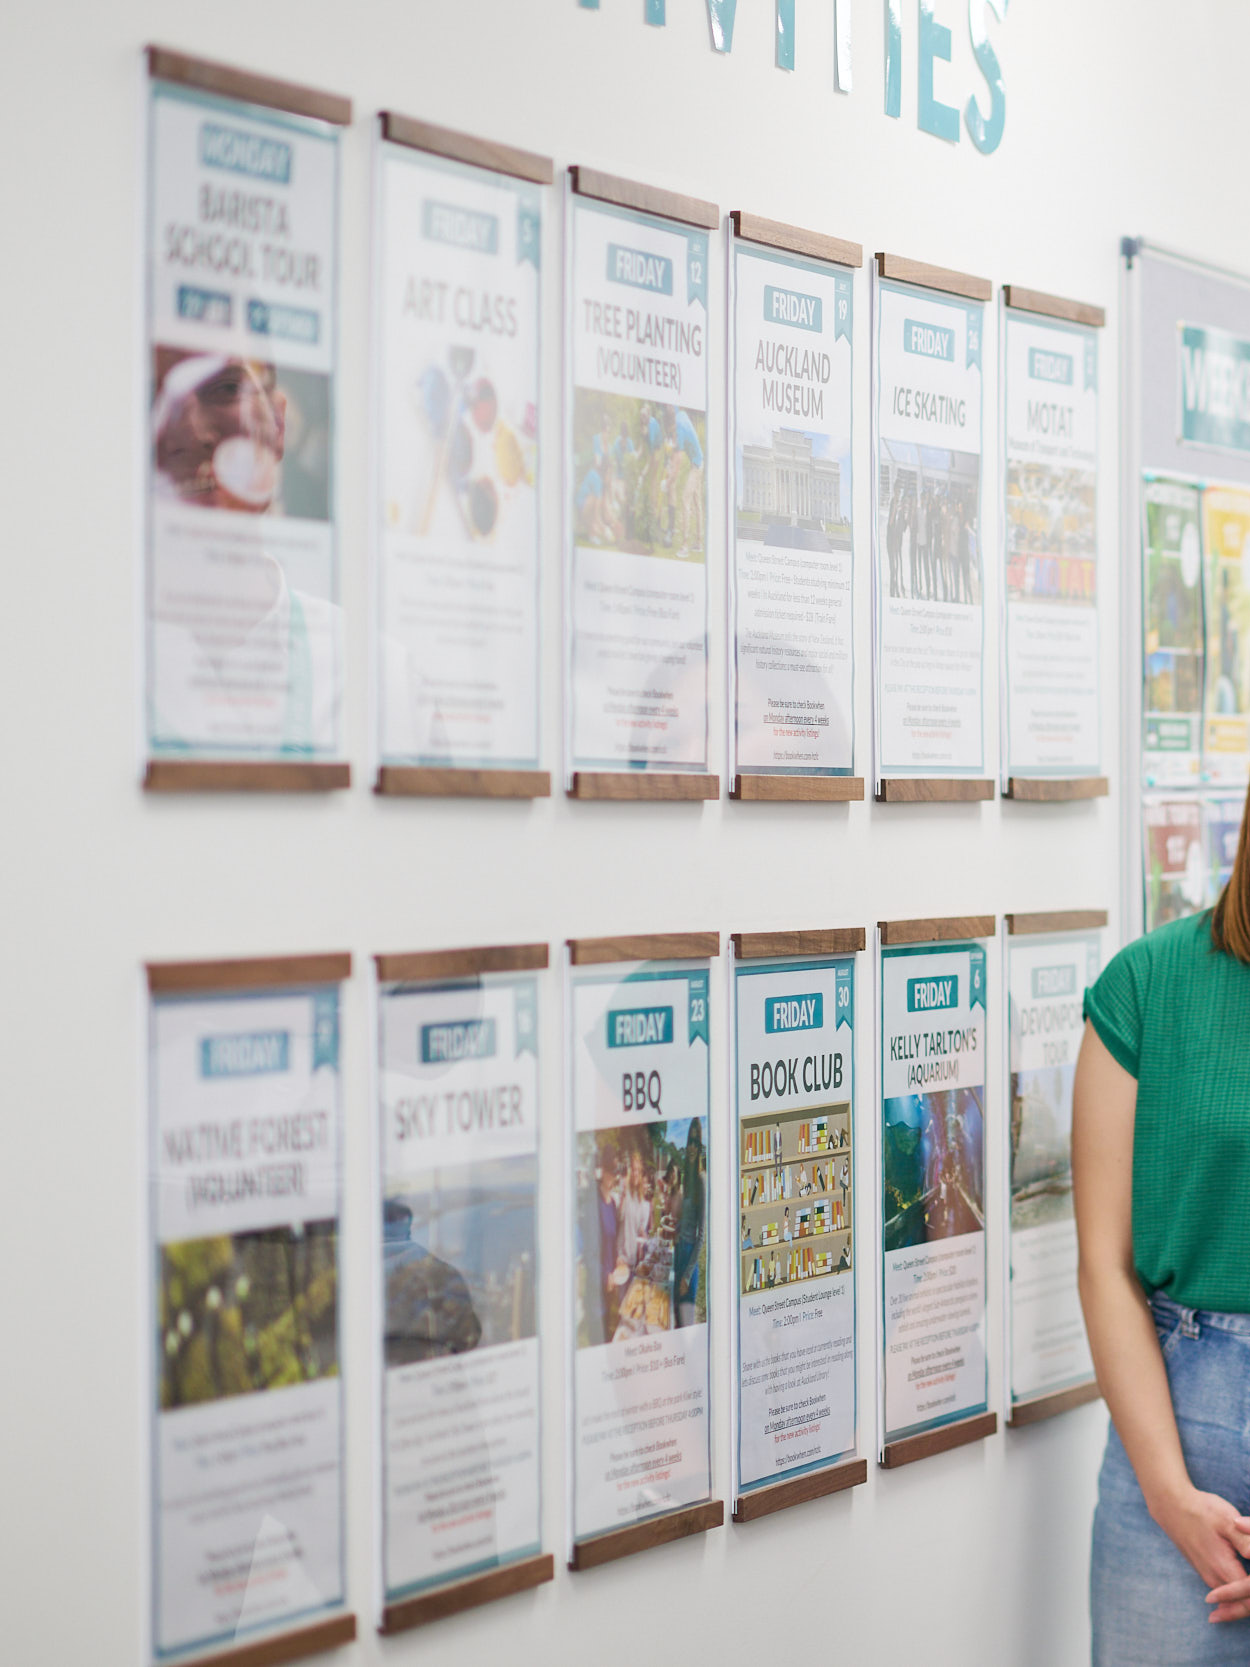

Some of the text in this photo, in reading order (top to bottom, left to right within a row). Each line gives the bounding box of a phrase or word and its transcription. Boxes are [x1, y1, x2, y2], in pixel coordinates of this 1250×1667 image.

[200, 184, 289, 238] BARISTA
[165, 223, 320, 290] SCHOOL TOUR
[615, 248, 665, 289] FRIDAY
[691, 260, 701, 284] 12
[403, 275, 519, 338] ART CLASS
[772, 290, 815, 326] FRIDAY
[838, 298, 847, 321] 19
[583, 296, 701, 357] TREE PLANTING
[911, 325, 948, 358] FRIDAY
[597, 345, 681, 395] (VOLUNTEER)
[754, 338, 831, 385] AUCKLAND
[1034, 351, 1069, 382] FRIDAY
[762, 378, 823, 420] MUSEUM
[893, 385, 965, 427] ICE SKATING
[1026, 399, 1072, 439] MOTAT
[691, 998, 704, 1022] 23
[838, 986, 849, 1007] 30
[914, 980, 952, 1008] FRIDAY
[615, 1009, 665, 1046] FRIDAY
[773, 998, 815, 1029] FRIDAY
[1020, 1001, 1083, 1037] DEVONPOR
[429, 1023, 490, 1060] FRIDAY
[890, 1027, 976, 1061] KELLY TARLTON'S
[1042, 1039, 1068, 1066] TOUR
[750, 1051, 842, 1101] BOOK CLUB
[907, 1058, 959, 1089] (AQUARIUM)
[622, 1067, 662, 1121] BBQ
[395, 1085, 524, 1141] SKY TOWER
[249, 1110, 328, 1158] FOREST
